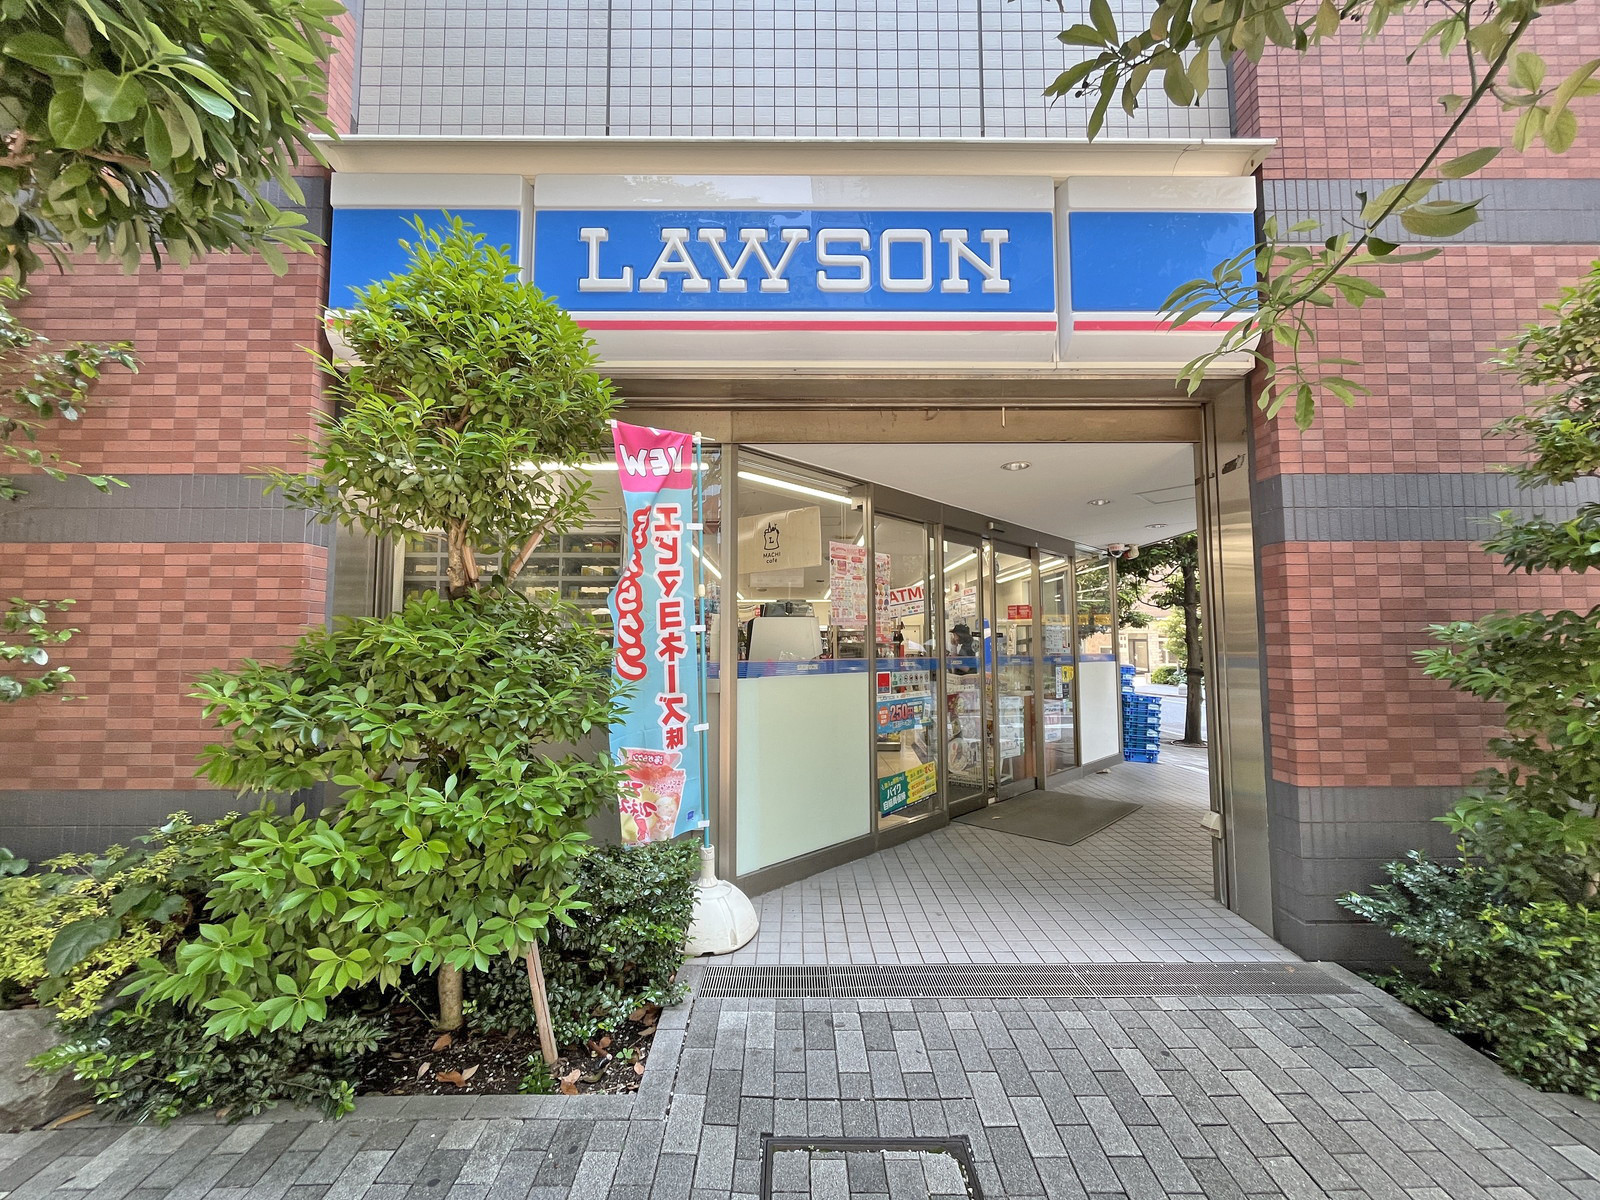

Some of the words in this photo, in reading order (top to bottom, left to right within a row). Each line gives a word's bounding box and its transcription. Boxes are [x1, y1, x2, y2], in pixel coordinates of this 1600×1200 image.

[577, 227, 1011, 294] LAWSON
[763, 551, 781, 559] MACHI
[886, 783, 902, 799] バイク
